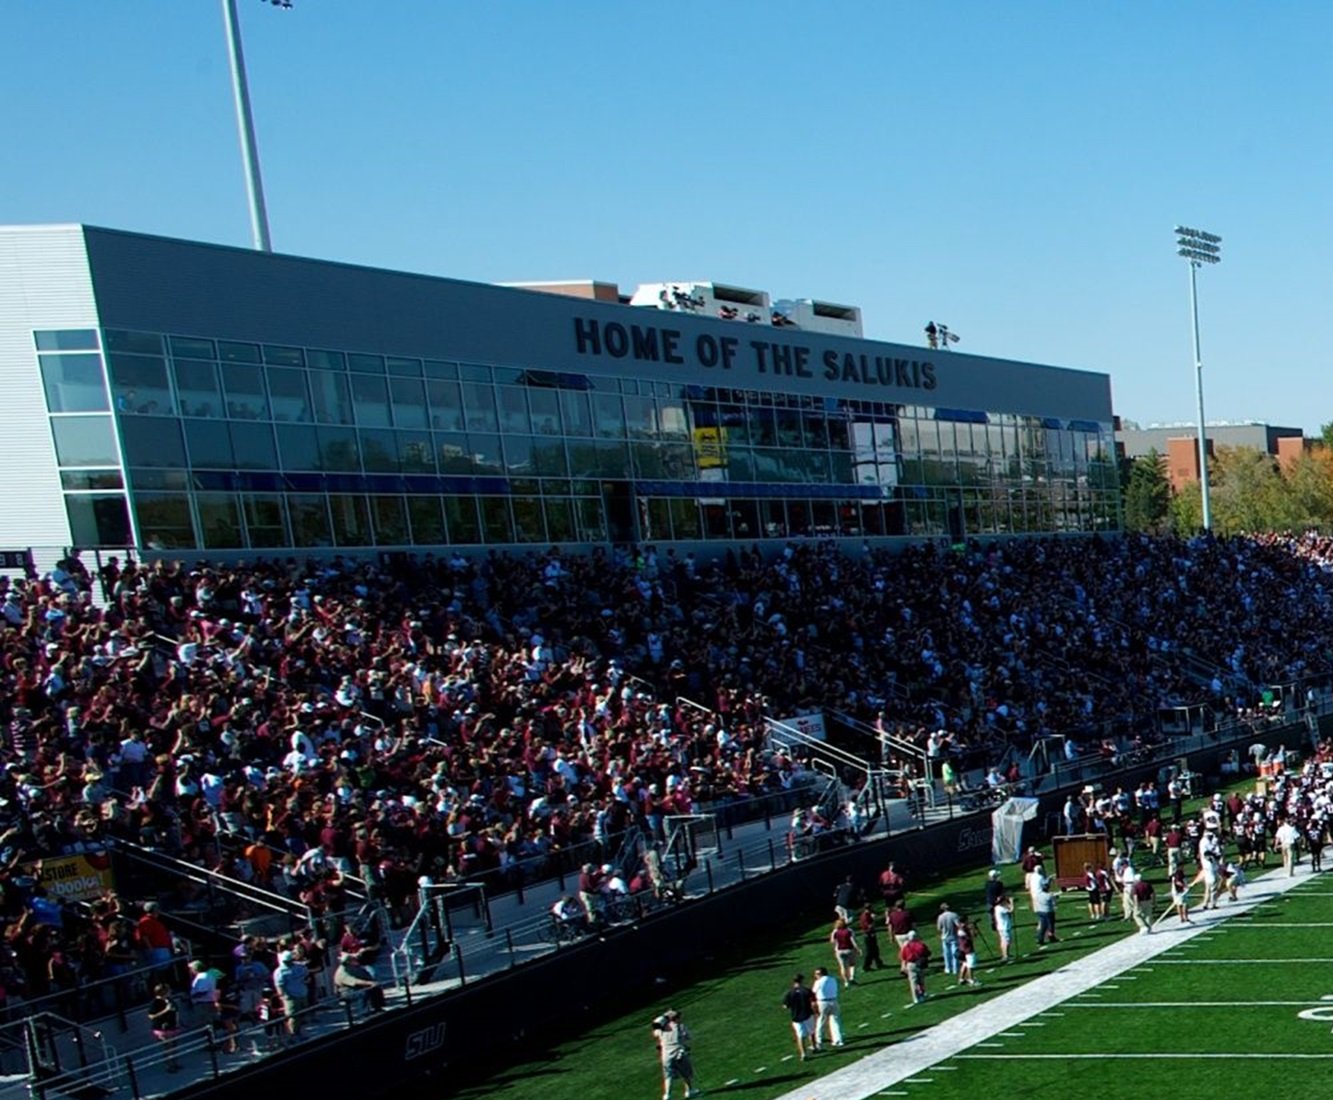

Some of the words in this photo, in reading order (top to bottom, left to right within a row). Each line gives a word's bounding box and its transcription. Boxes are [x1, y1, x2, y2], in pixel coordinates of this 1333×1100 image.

[574, 317, 685, 364] HOME
[696, 333, 739, 370] OF
[750, 341, 813, 378] THE
[822, 350, 937, 391] SALUKIS
[403, 1021, 447, 1061] SIU
